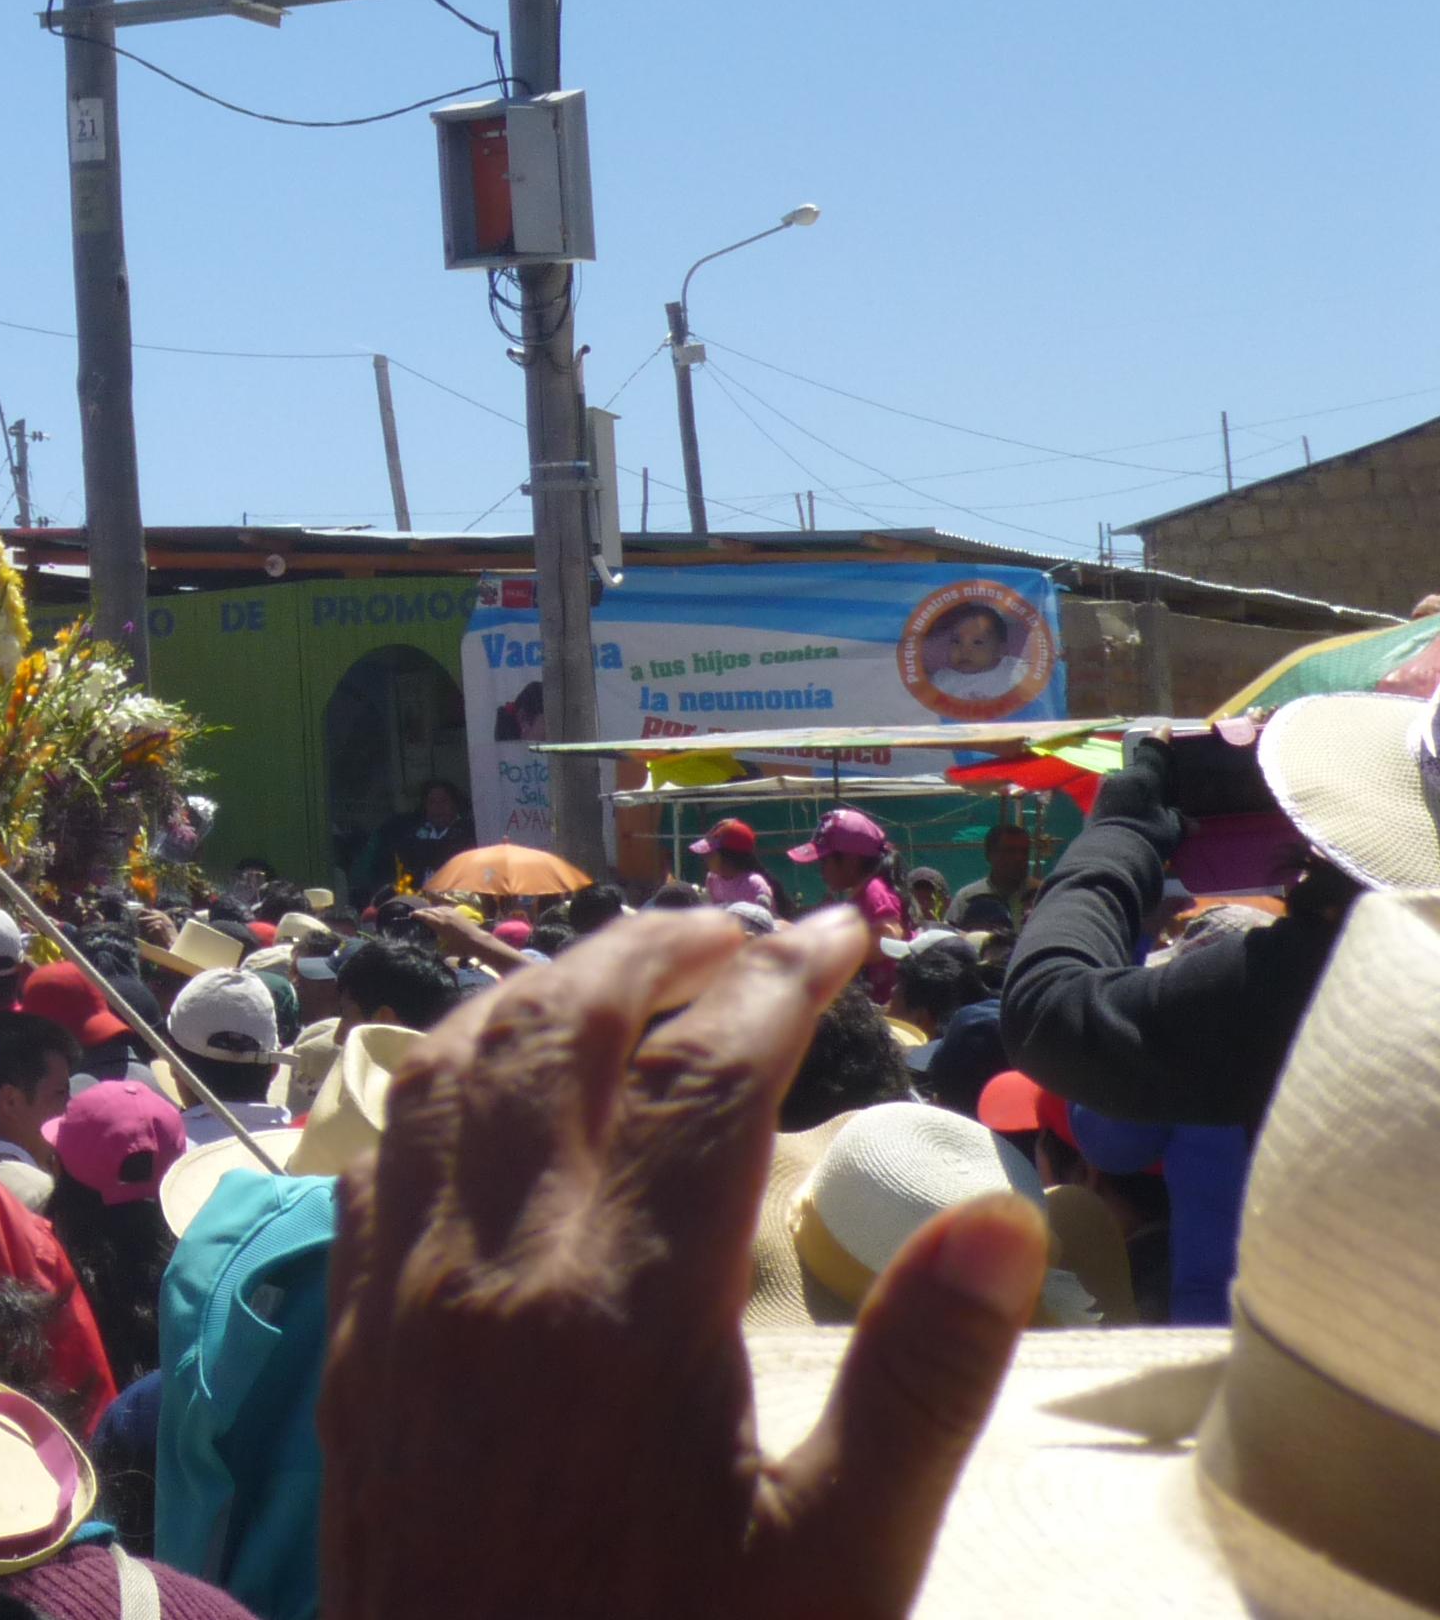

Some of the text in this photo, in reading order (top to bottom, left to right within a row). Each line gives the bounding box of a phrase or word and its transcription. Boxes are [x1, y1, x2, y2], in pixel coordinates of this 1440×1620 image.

[222, 600, 265, 632] DE
[312, 586, 480, 627] PROMOC
[481, 633, 840, 682] Vaca a tus hijos contra
[639, 682, 834, 713] la neumonía
